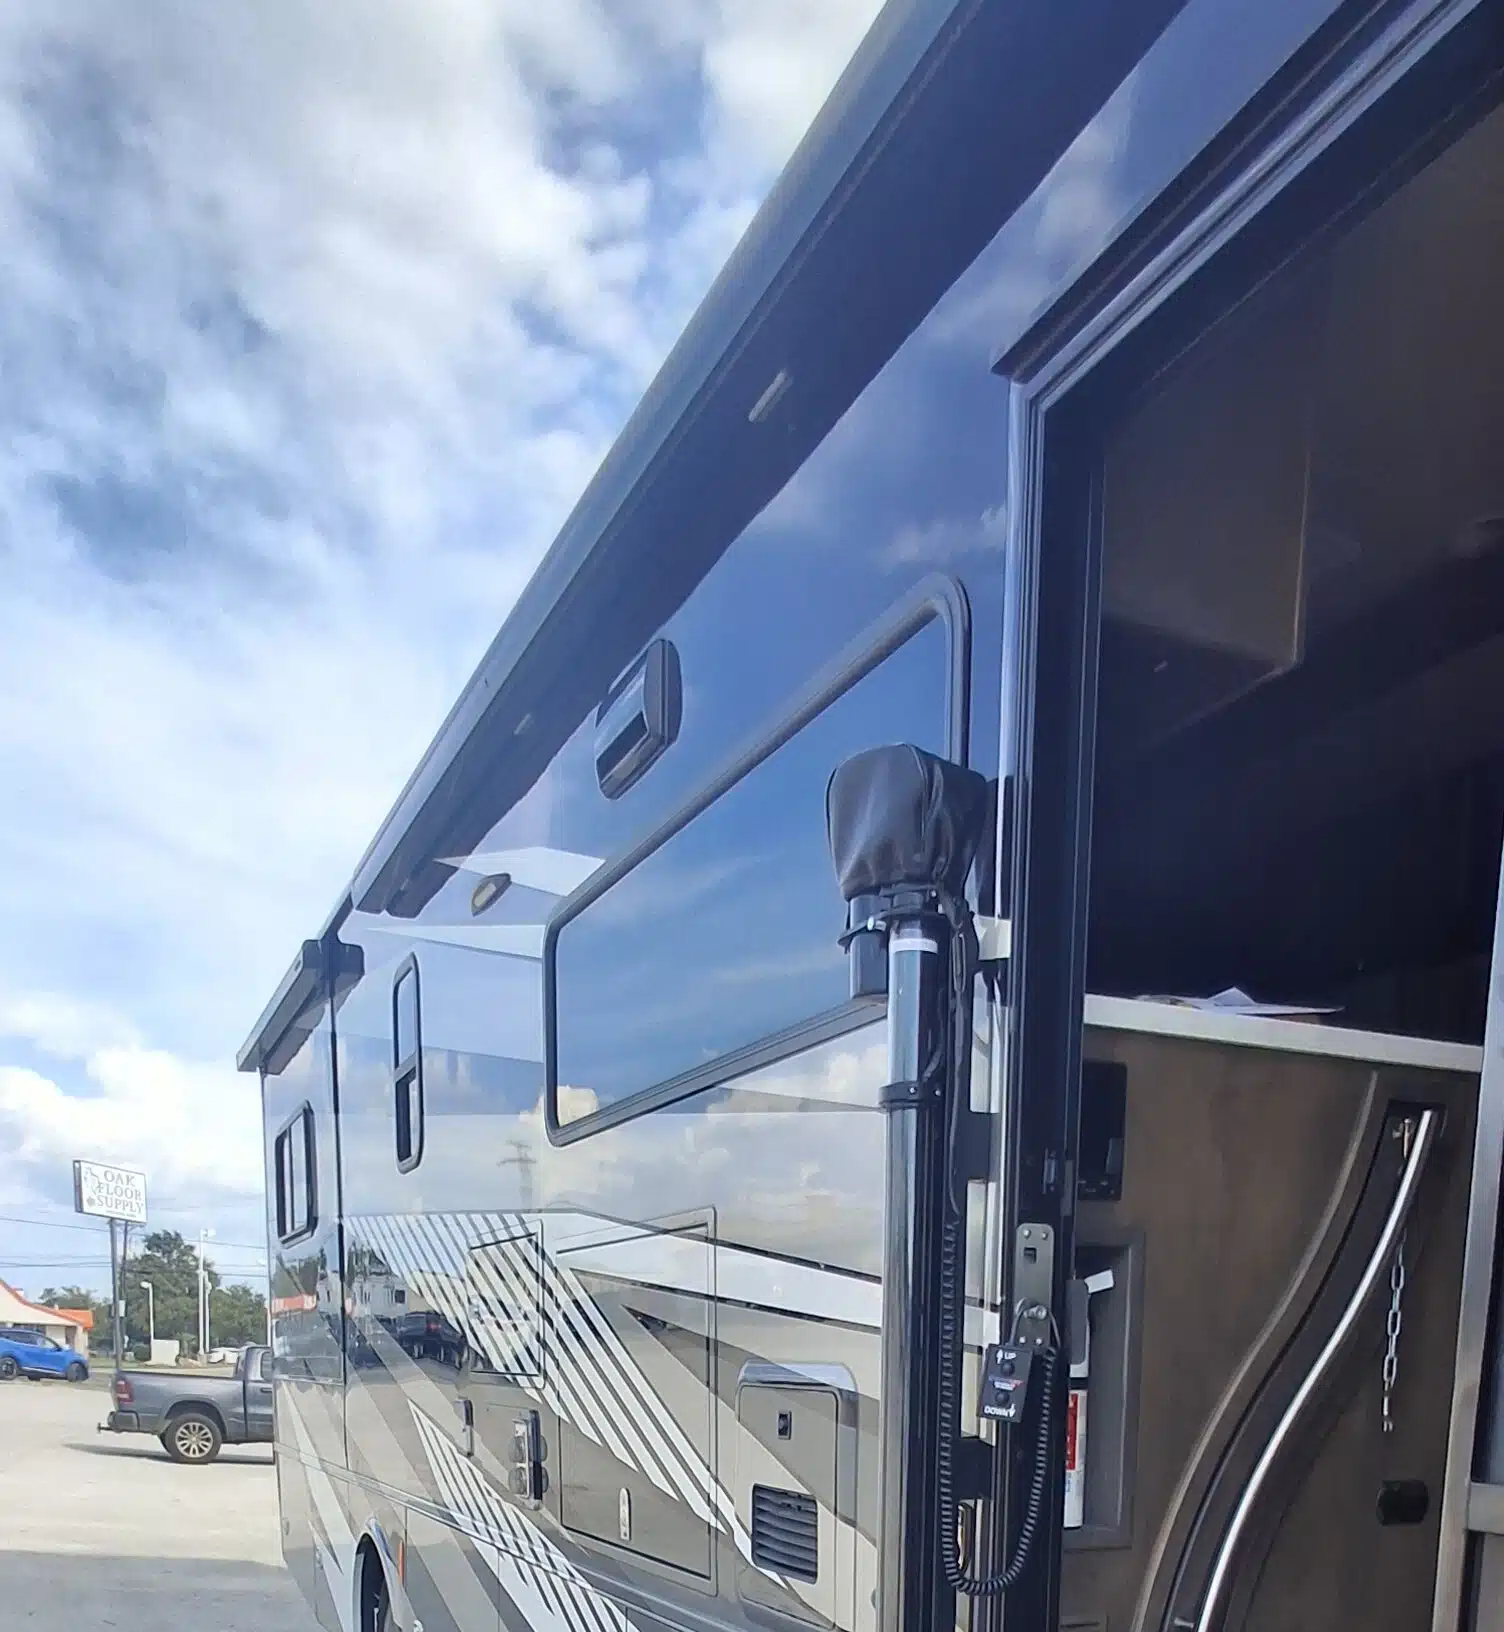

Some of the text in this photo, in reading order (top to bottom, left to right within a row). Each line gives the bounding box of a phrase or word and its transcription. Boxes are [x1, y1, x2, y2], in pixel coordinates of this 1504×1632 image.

[104, 1170, 136, 1187] OAK
[97, 1182, 142, 1201] FLOOR
[97, 1195, 144, 1214] SUPPLY
[1004, 1352, 1017, 1360] UP
[984, 1405, 1009, 1417] DOWN
